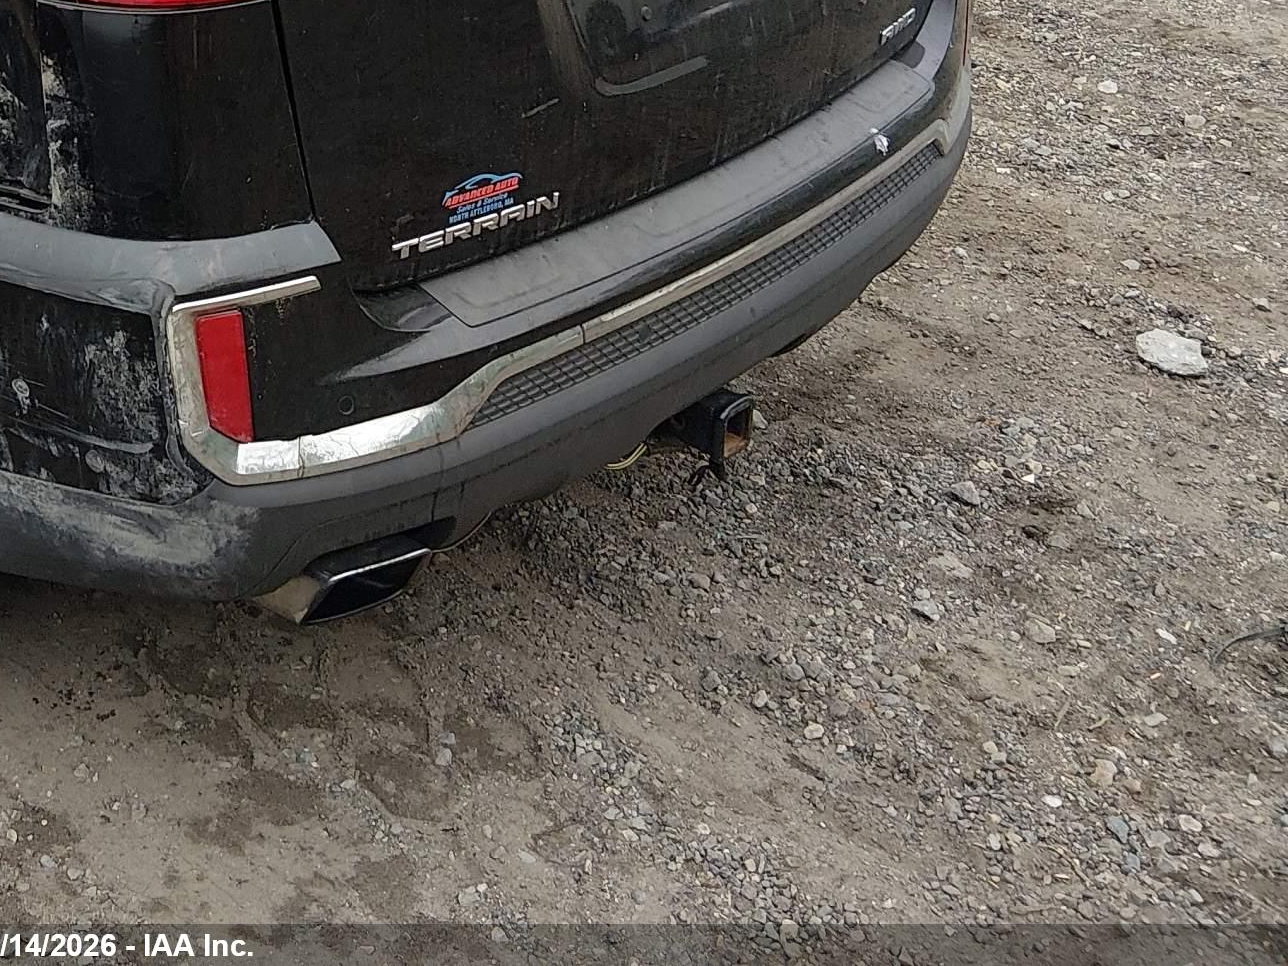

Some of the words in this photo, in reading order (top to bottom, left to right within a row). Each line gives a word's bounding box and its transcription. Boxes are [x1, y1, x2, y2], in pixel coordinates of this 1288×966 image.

[445, 184, 494, 207] ADVANCED
[495, 176, 519, 192] AUTO
[456, 202, 475, 214] Sales
[483, 192, 509, 205] Service
[449, 212, 469, 224] NORTH
[504, 196, 514, 207] MA
[392, 191, 560, 260] TERRAIN
